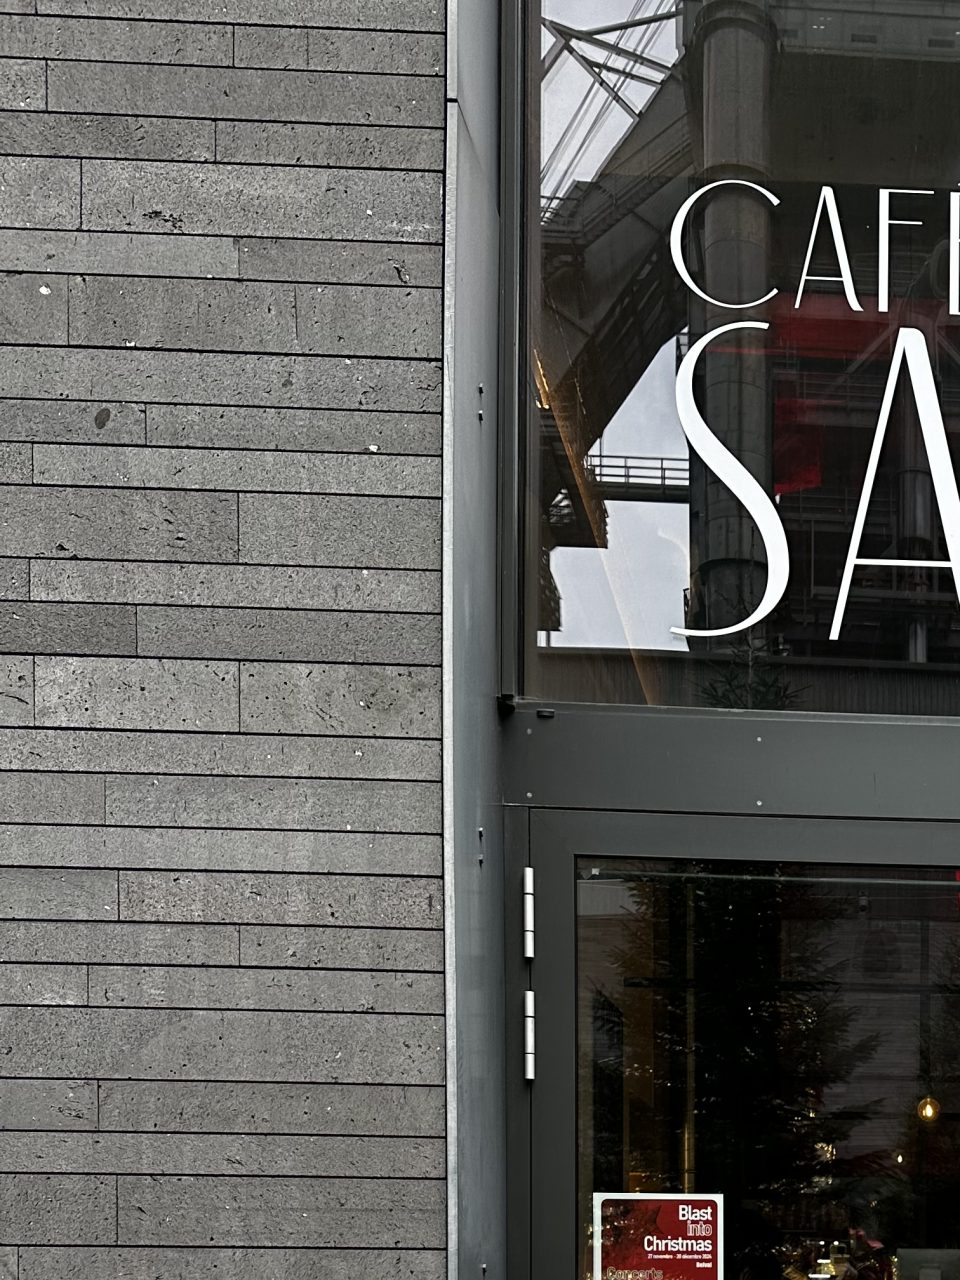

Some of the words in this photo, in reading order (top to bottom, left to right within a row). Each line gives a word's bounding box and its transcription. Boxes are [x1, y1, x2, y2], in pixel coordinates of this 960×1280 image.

[678, 1204, 713, 1220] Blast
[686, 1220, 713, 1236] into
[643, 1235, 713, 1251] Christmas
[606, 1266, 663, 1280] Concerts
